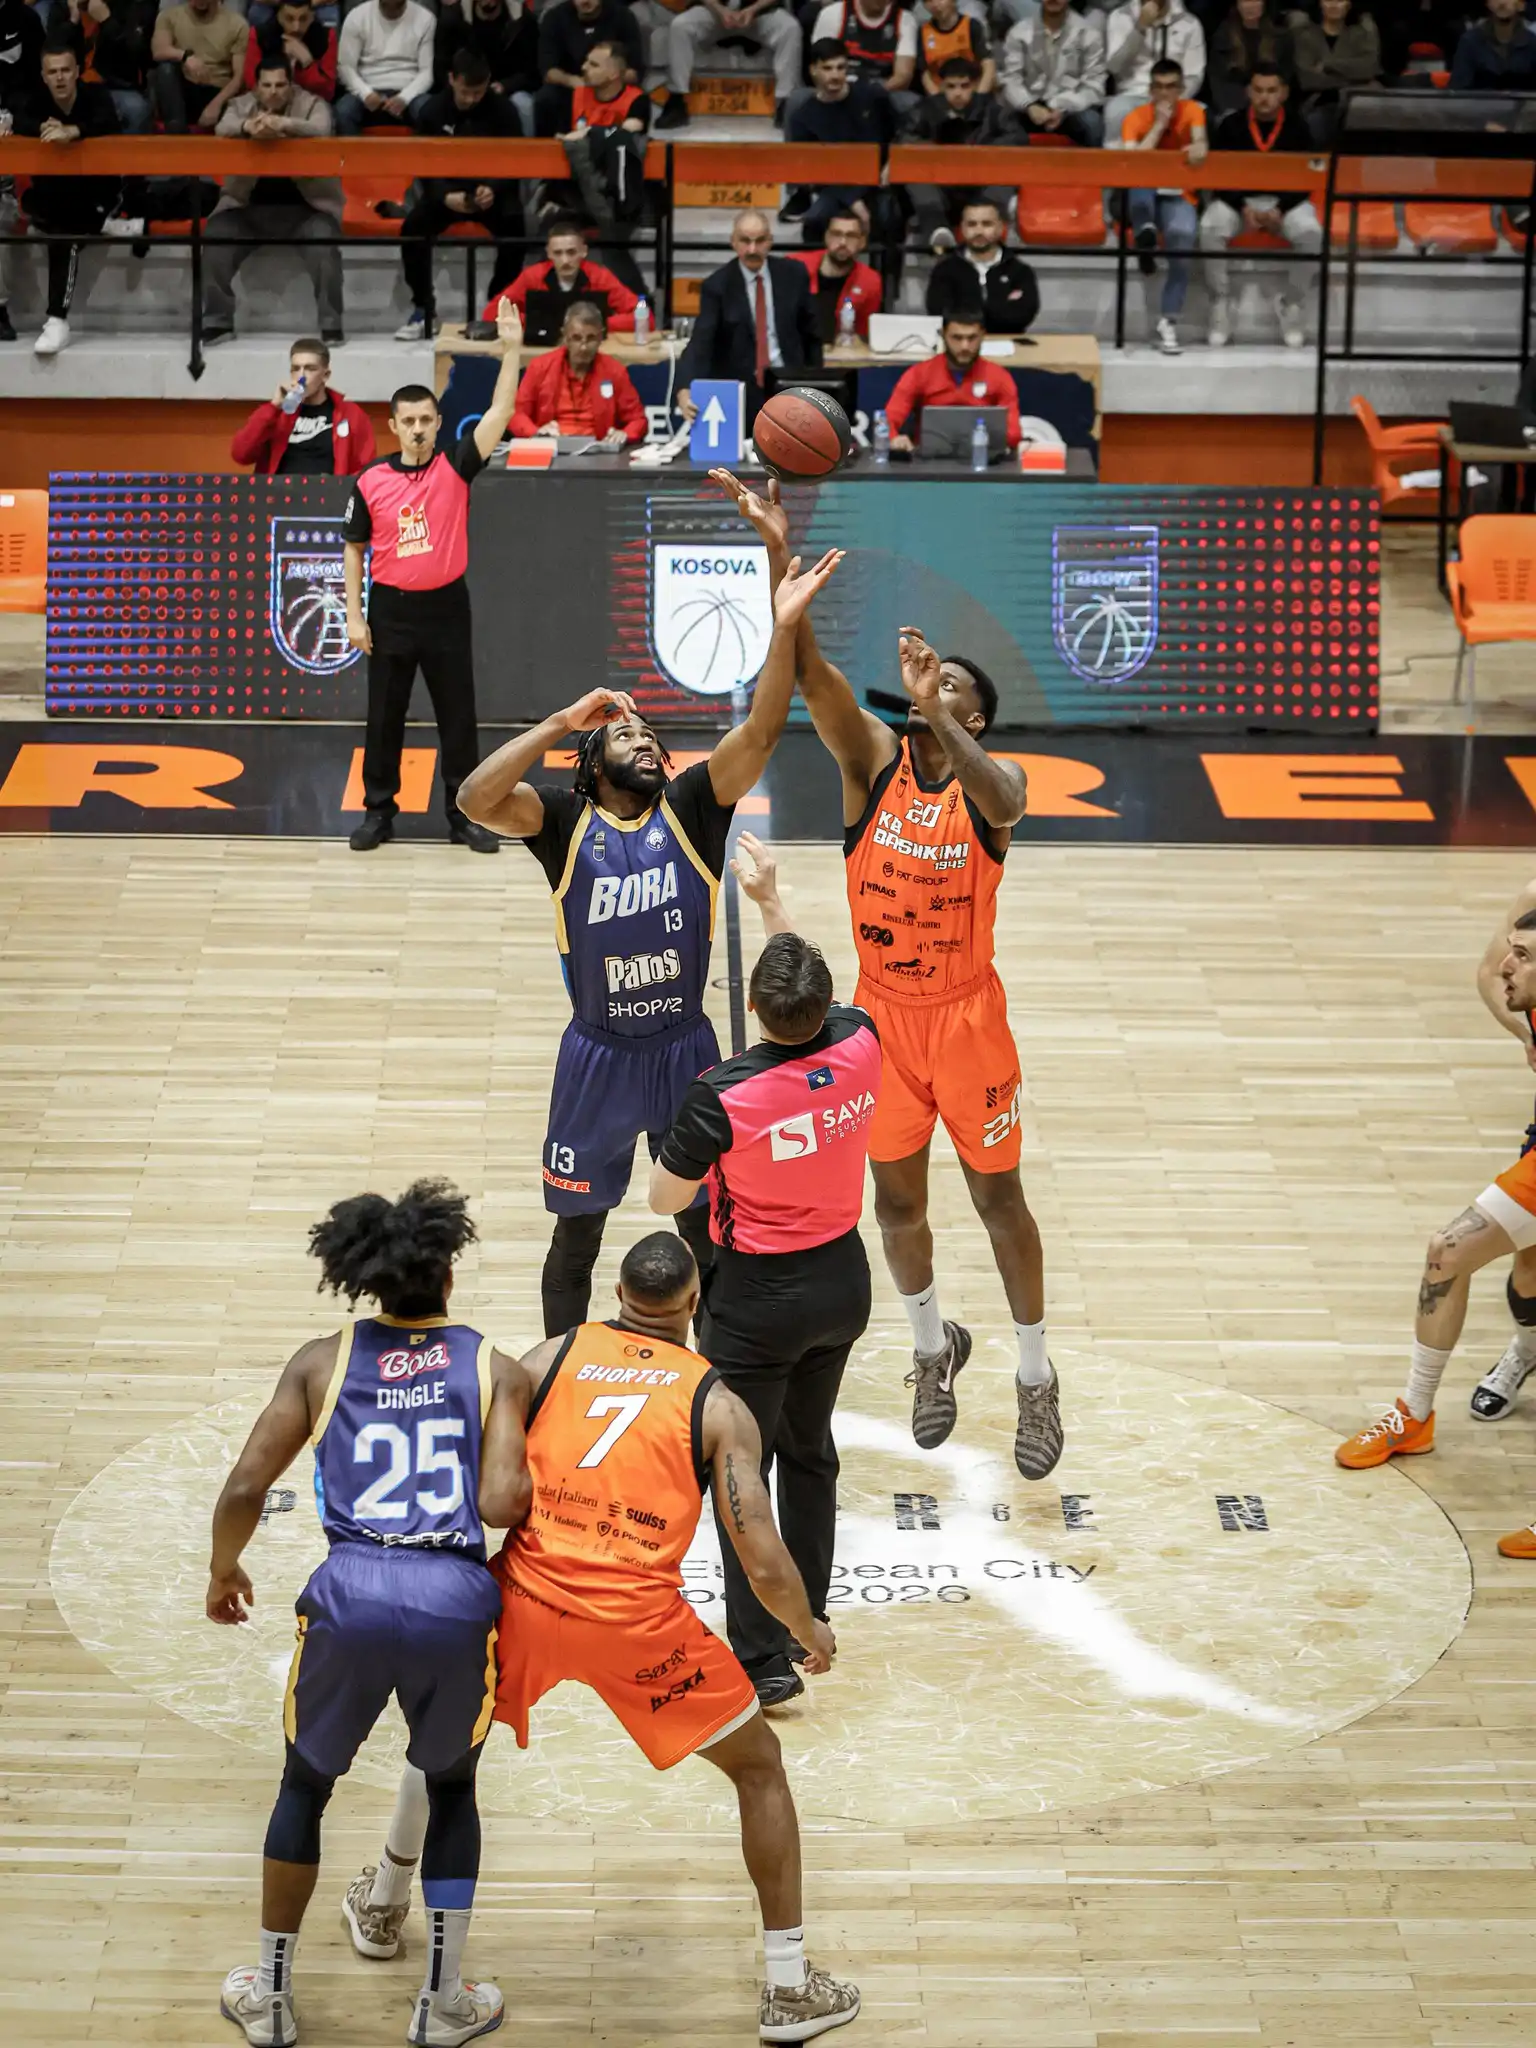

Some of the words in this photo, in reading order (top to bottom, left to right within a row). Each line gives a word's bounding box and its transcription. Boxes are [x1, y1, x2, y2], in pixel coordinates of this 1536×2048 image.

[670, 559, 758, 576] KOSOVA
[877, 810, 904, 836] KB
[905, 797, 944, 829] 20
[933, 858, 967, 872] 1945
[588, 861, 679, 924] BORA
[913, 875, 949, 886] GROUP
[663, 909, 684, 933] 13
[822, 1090, 876, 1129] SAVA
[551, 1142, 575, 1174] 13
[381, 1344, 447, 1379] Bora
[575, 1364, 681, 1387] SHORTER
[377, 1381, 446, 1410] DINGLE
[576, 1393, 650, 1469] 7
[353, 1417, 465, 1520] 25
[625, 1508, 668, 1531] swiss
[621, 1532, 661, 1552] PROJECT
[983, 1559, 1097, 1583] City
[827, 1584, 971, 1604] 2026
